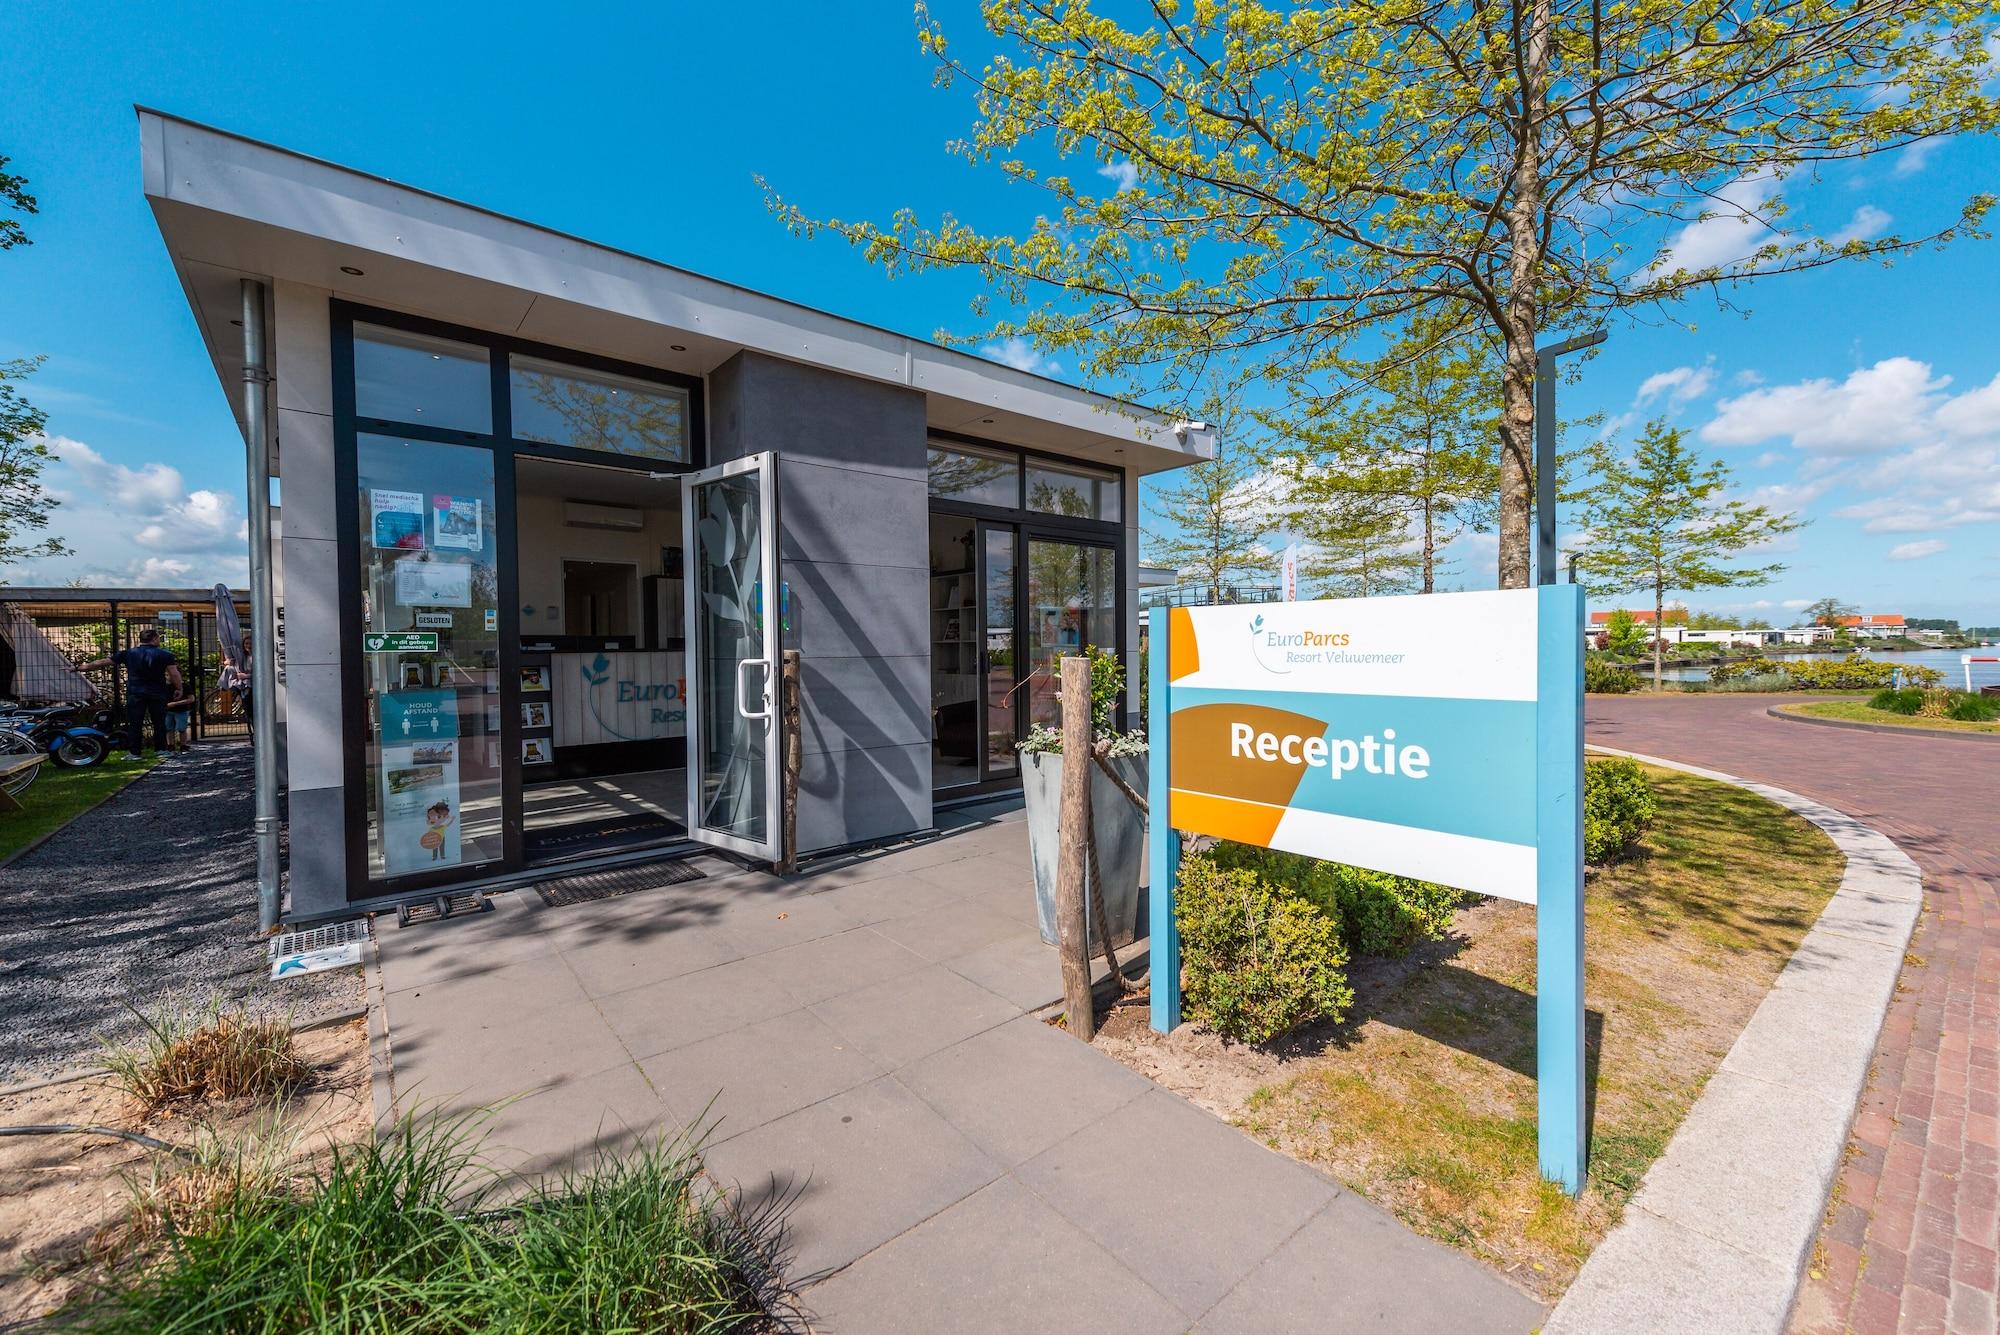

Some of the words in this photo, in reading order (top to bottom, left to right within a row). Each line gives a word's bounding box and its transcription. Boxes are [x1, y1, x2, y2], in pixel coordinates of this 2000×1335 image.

[418, 616, 451, 624] GESLOTEN
[1267, 631, 1349, 647] EuroParcs
[1286, 651, 1322, 663] Resort
[1325, 650, 1406, 664] Veluwemeer
[1231, 723, 1430, 780] Receptie
